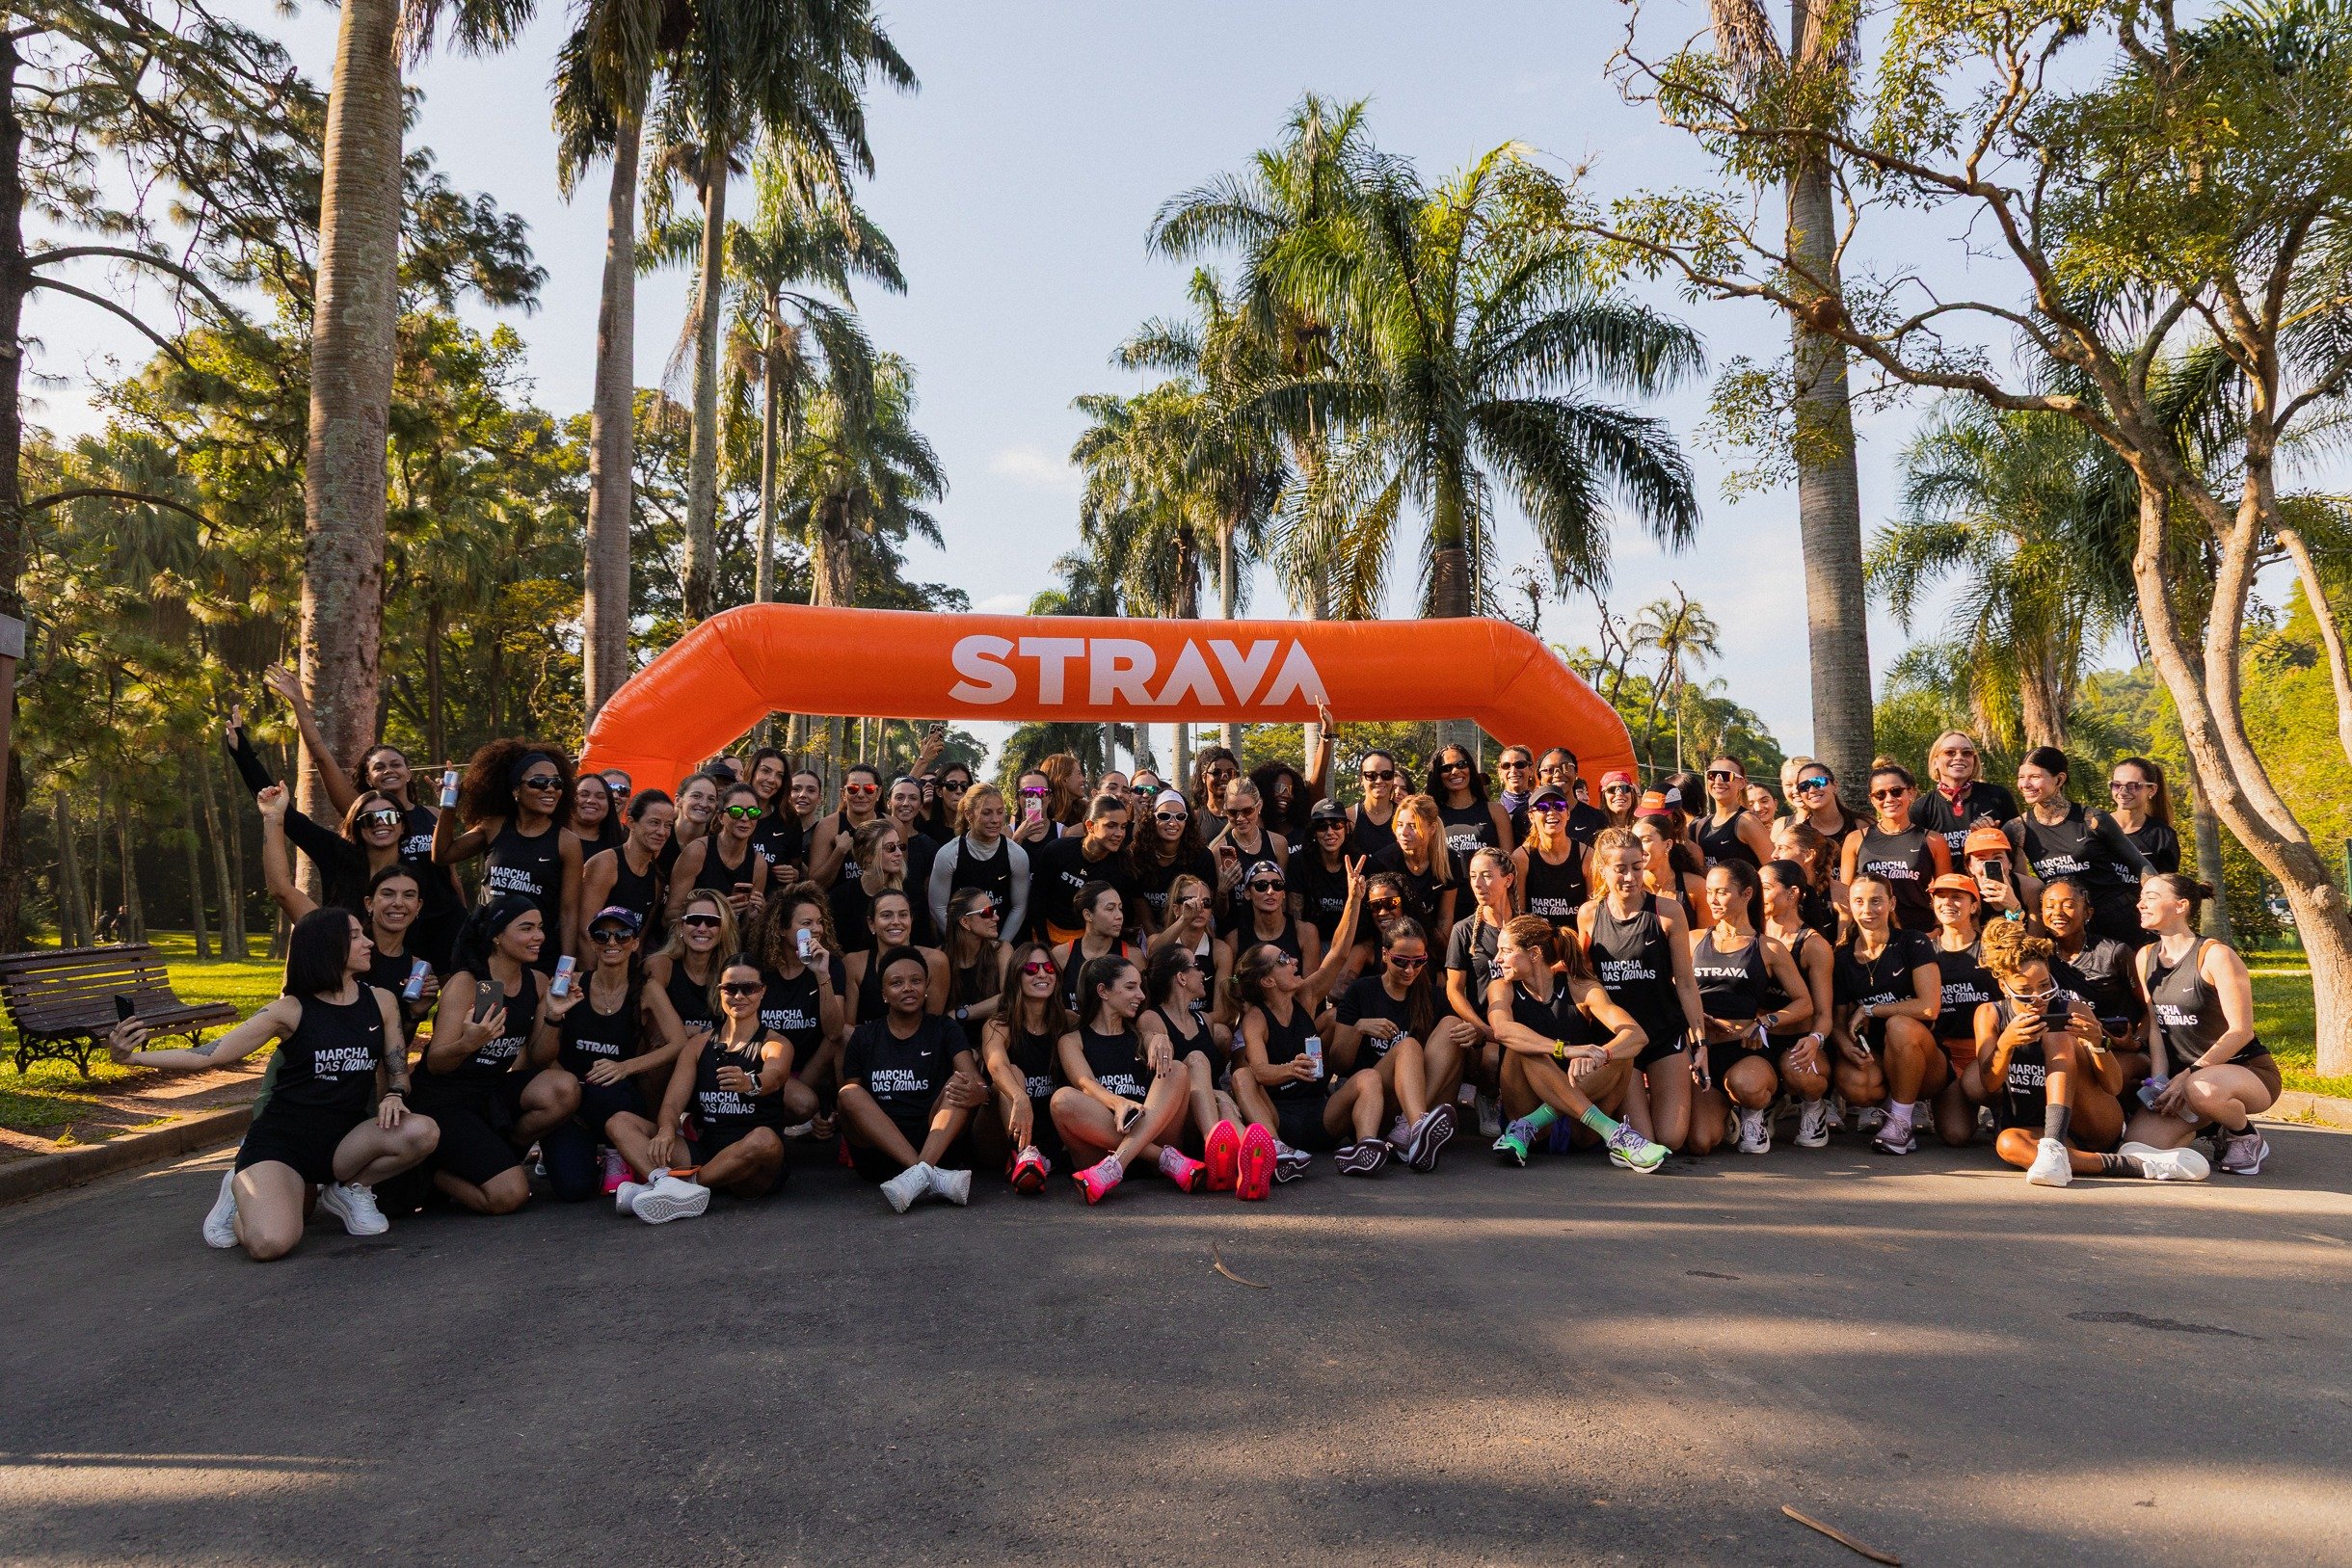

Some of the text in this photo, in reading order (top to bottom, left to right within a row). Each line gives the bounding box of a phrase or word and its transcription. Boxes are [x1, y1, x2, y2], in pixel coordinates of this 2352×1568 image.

[948, 634, 1330, 706] STRAVA
[1866, 861, 1908, 872] MARCHA
[2034, 855, 2075, 871] MARCHA
[490, 866, 531, 883] MARCHA
[1888, 869, 1920, 881] MINAS
[2039, 861, 2091, 879] DAS MINAS
[1060, 871, 1085, 888] STR
[490, 878, 543, 895] DAS MINAS
[1531, 897, 1567, 907] MARCHA
[1533, 905, 1579, 916] DAS MINAS
[1600, 959, 1644, 971] MARCHA
[1489, 969, 1504, 979] DA
[1602, 970, 1656, 981] DAS MINAS
[1694, 967, 1749, 979] STRAVA
[1940, 983, 1974, 994] ARCHA
[1941, 993, 1990, 1004] AS MINAS
[762, 1009, 803, 1020] MARCHA
[2163, 1014, 2199, 1025] MINAS
[782, 1018, 816, 1030] MINAS
[576, 1039, 619, 1055] STRAVA
[1370, 1037, 1388, 1050] DAS
[314, 1047, 369, 1062] MARCHA
[314, 1058, 378, 1074] DAS MINAS
[2008, 1064, 2045, 1076] MARCH
[871, 1069, 915, 1081] MARCHA
[2008, 1075, 2030, 1086] DAS
[871, 1079, 929, 1092] DAS MINAS
[1114, 1083, 1146, 1097] MINAS
[718, 1102, 756, 1114] MINAS
